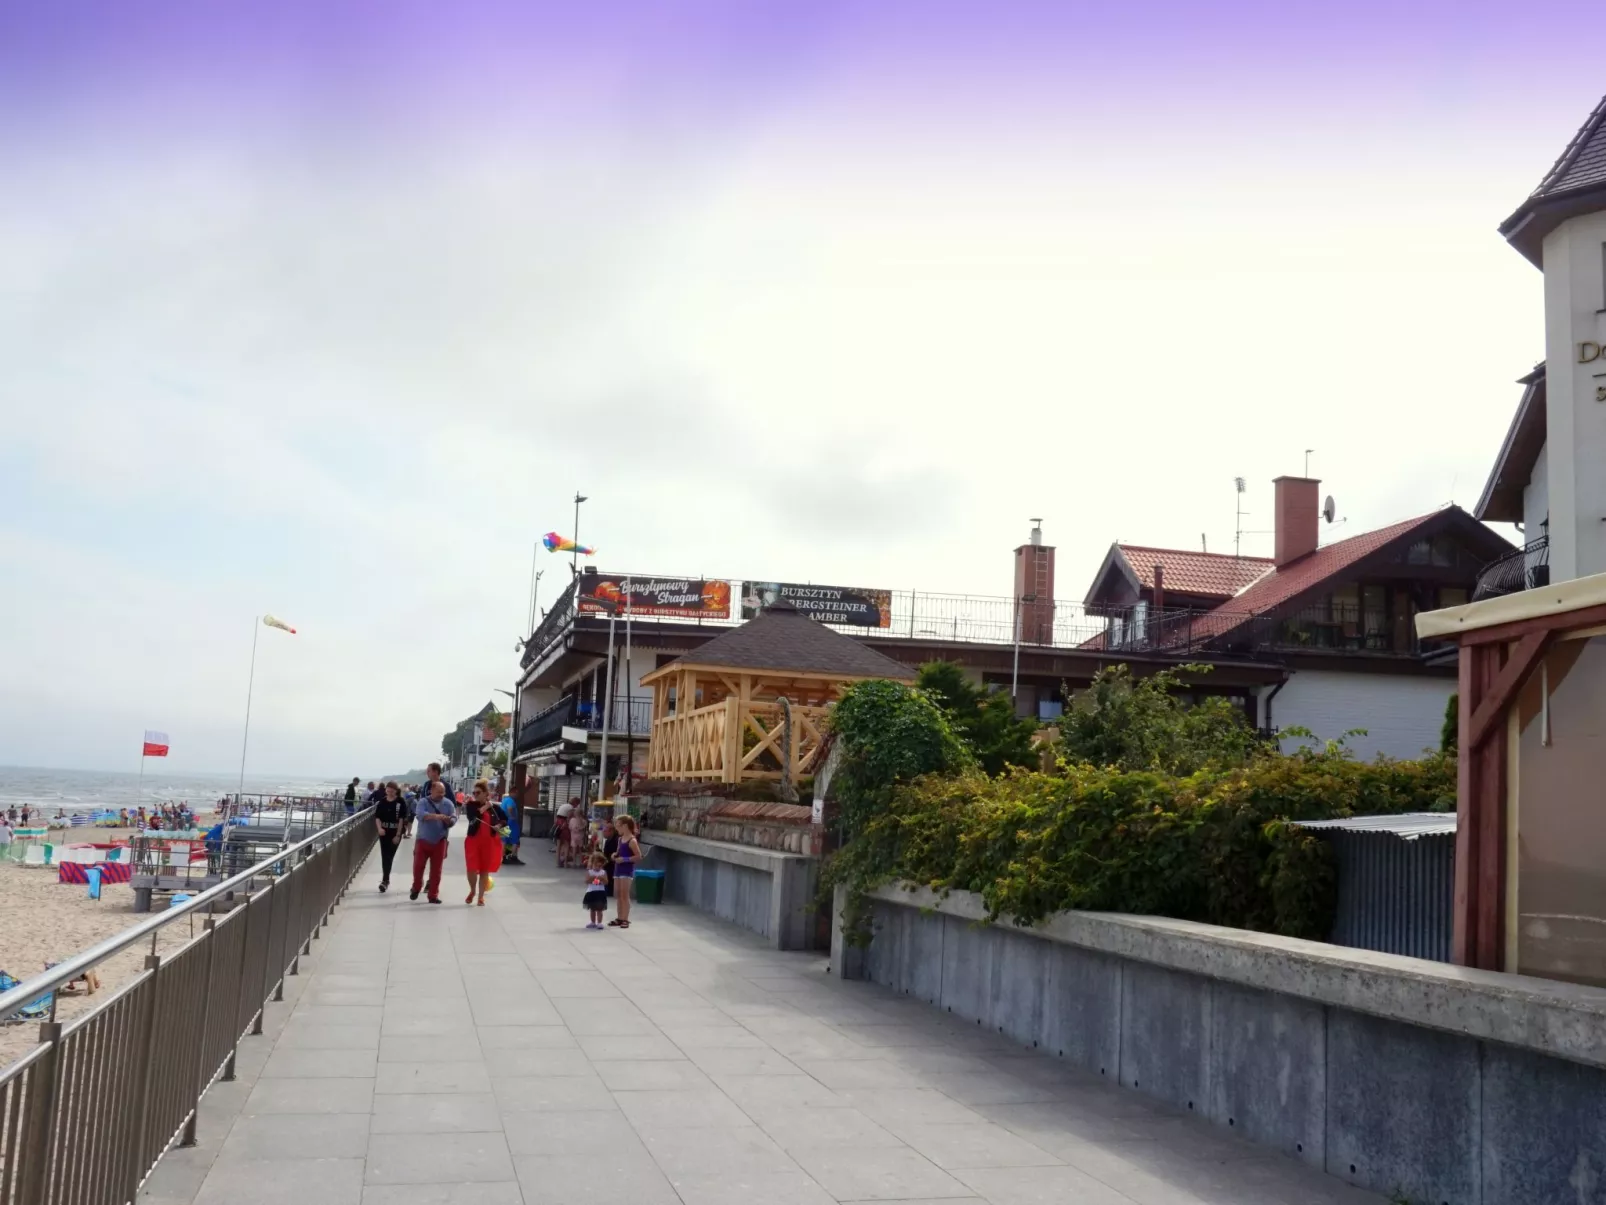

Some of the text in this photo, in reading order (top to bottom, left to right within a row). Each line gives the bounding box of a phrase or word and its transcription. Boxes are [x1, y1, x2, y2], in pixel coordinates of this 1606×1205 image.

[619, 579, 689, 596] Bursztynowy
[780, 587, 843, 599] BURSZTYN
[657, 591, 700, 606] Stragan
[808, 612, 848, 623] AMBER
